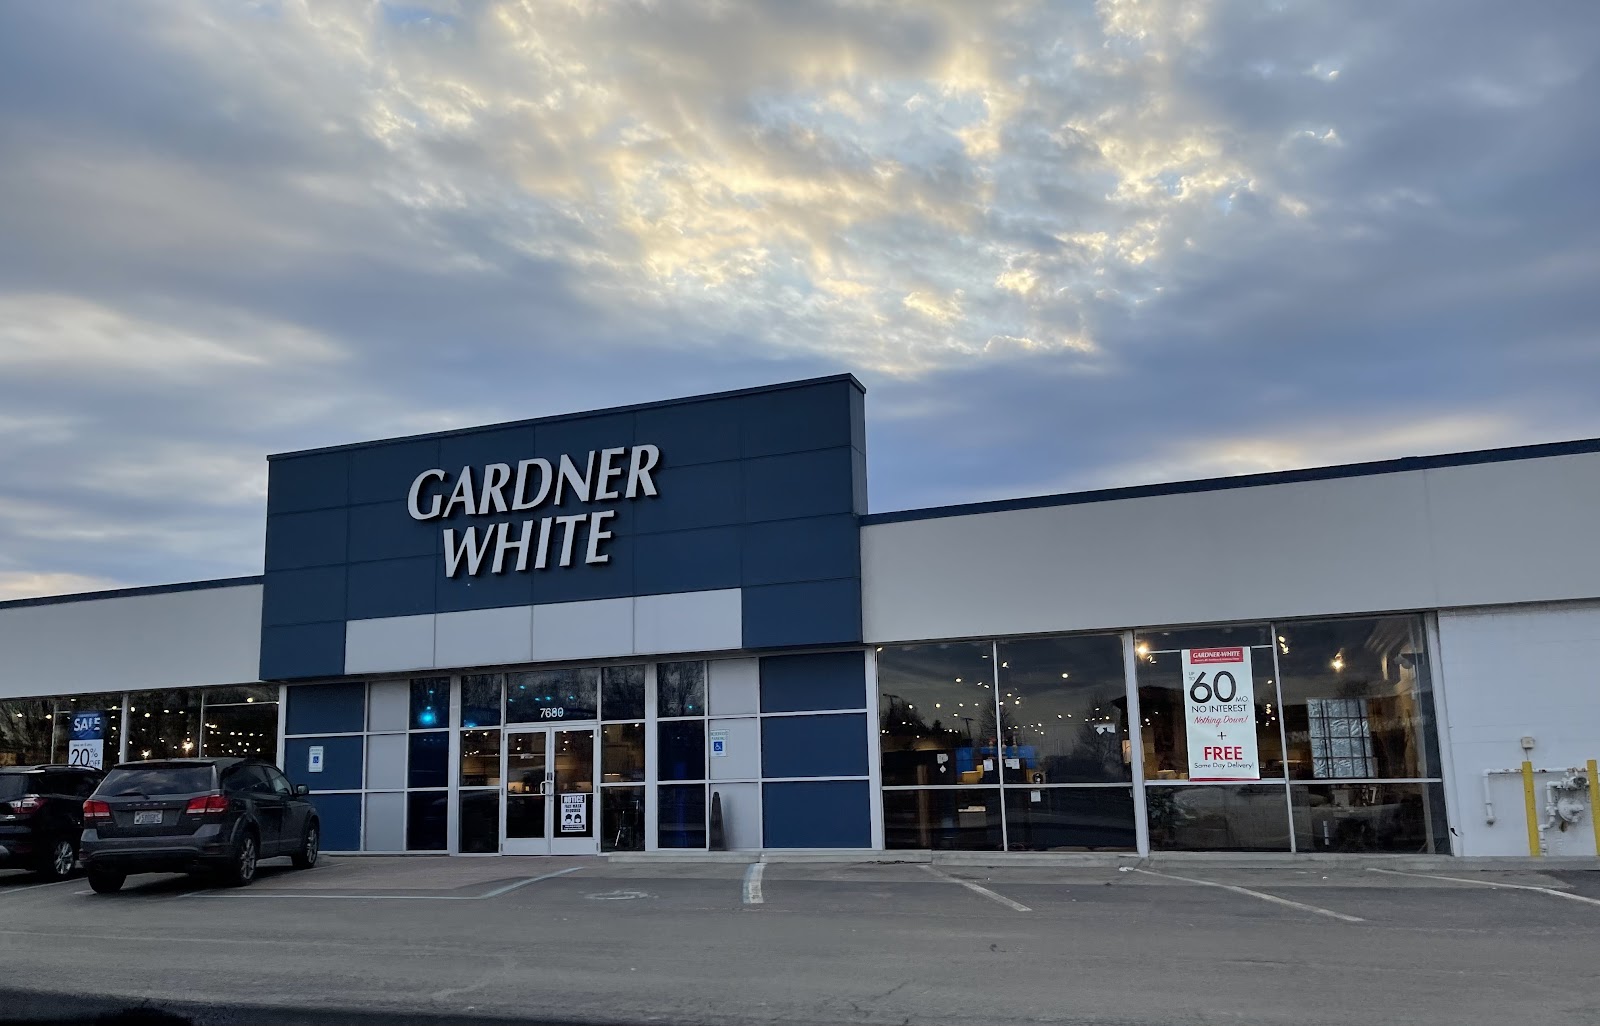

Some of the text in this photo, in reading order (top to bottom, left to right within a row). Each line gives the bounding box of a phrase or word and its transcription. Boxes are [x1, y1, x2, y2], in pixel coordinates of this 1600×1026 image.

[407, 444, 660, 521] GARDNER
[443, 510, 615, 578] WHITE
[1192, 650, 1241, 659] GARDNER-WHITE
[1189, 670, 1237, 704] 60
[539, 706, 564, 718] 7680
[1191, 704, 1247, 713] NO INTEREST
[73, 717, 101, 732] SALE
[1193, 714, 1249, 728] Nothing Down!
[1203, 746, 1243, 761] FREE
[1212, 762, 1226, 770] Day
[1227, 761, 1255, 770] Delivery!
